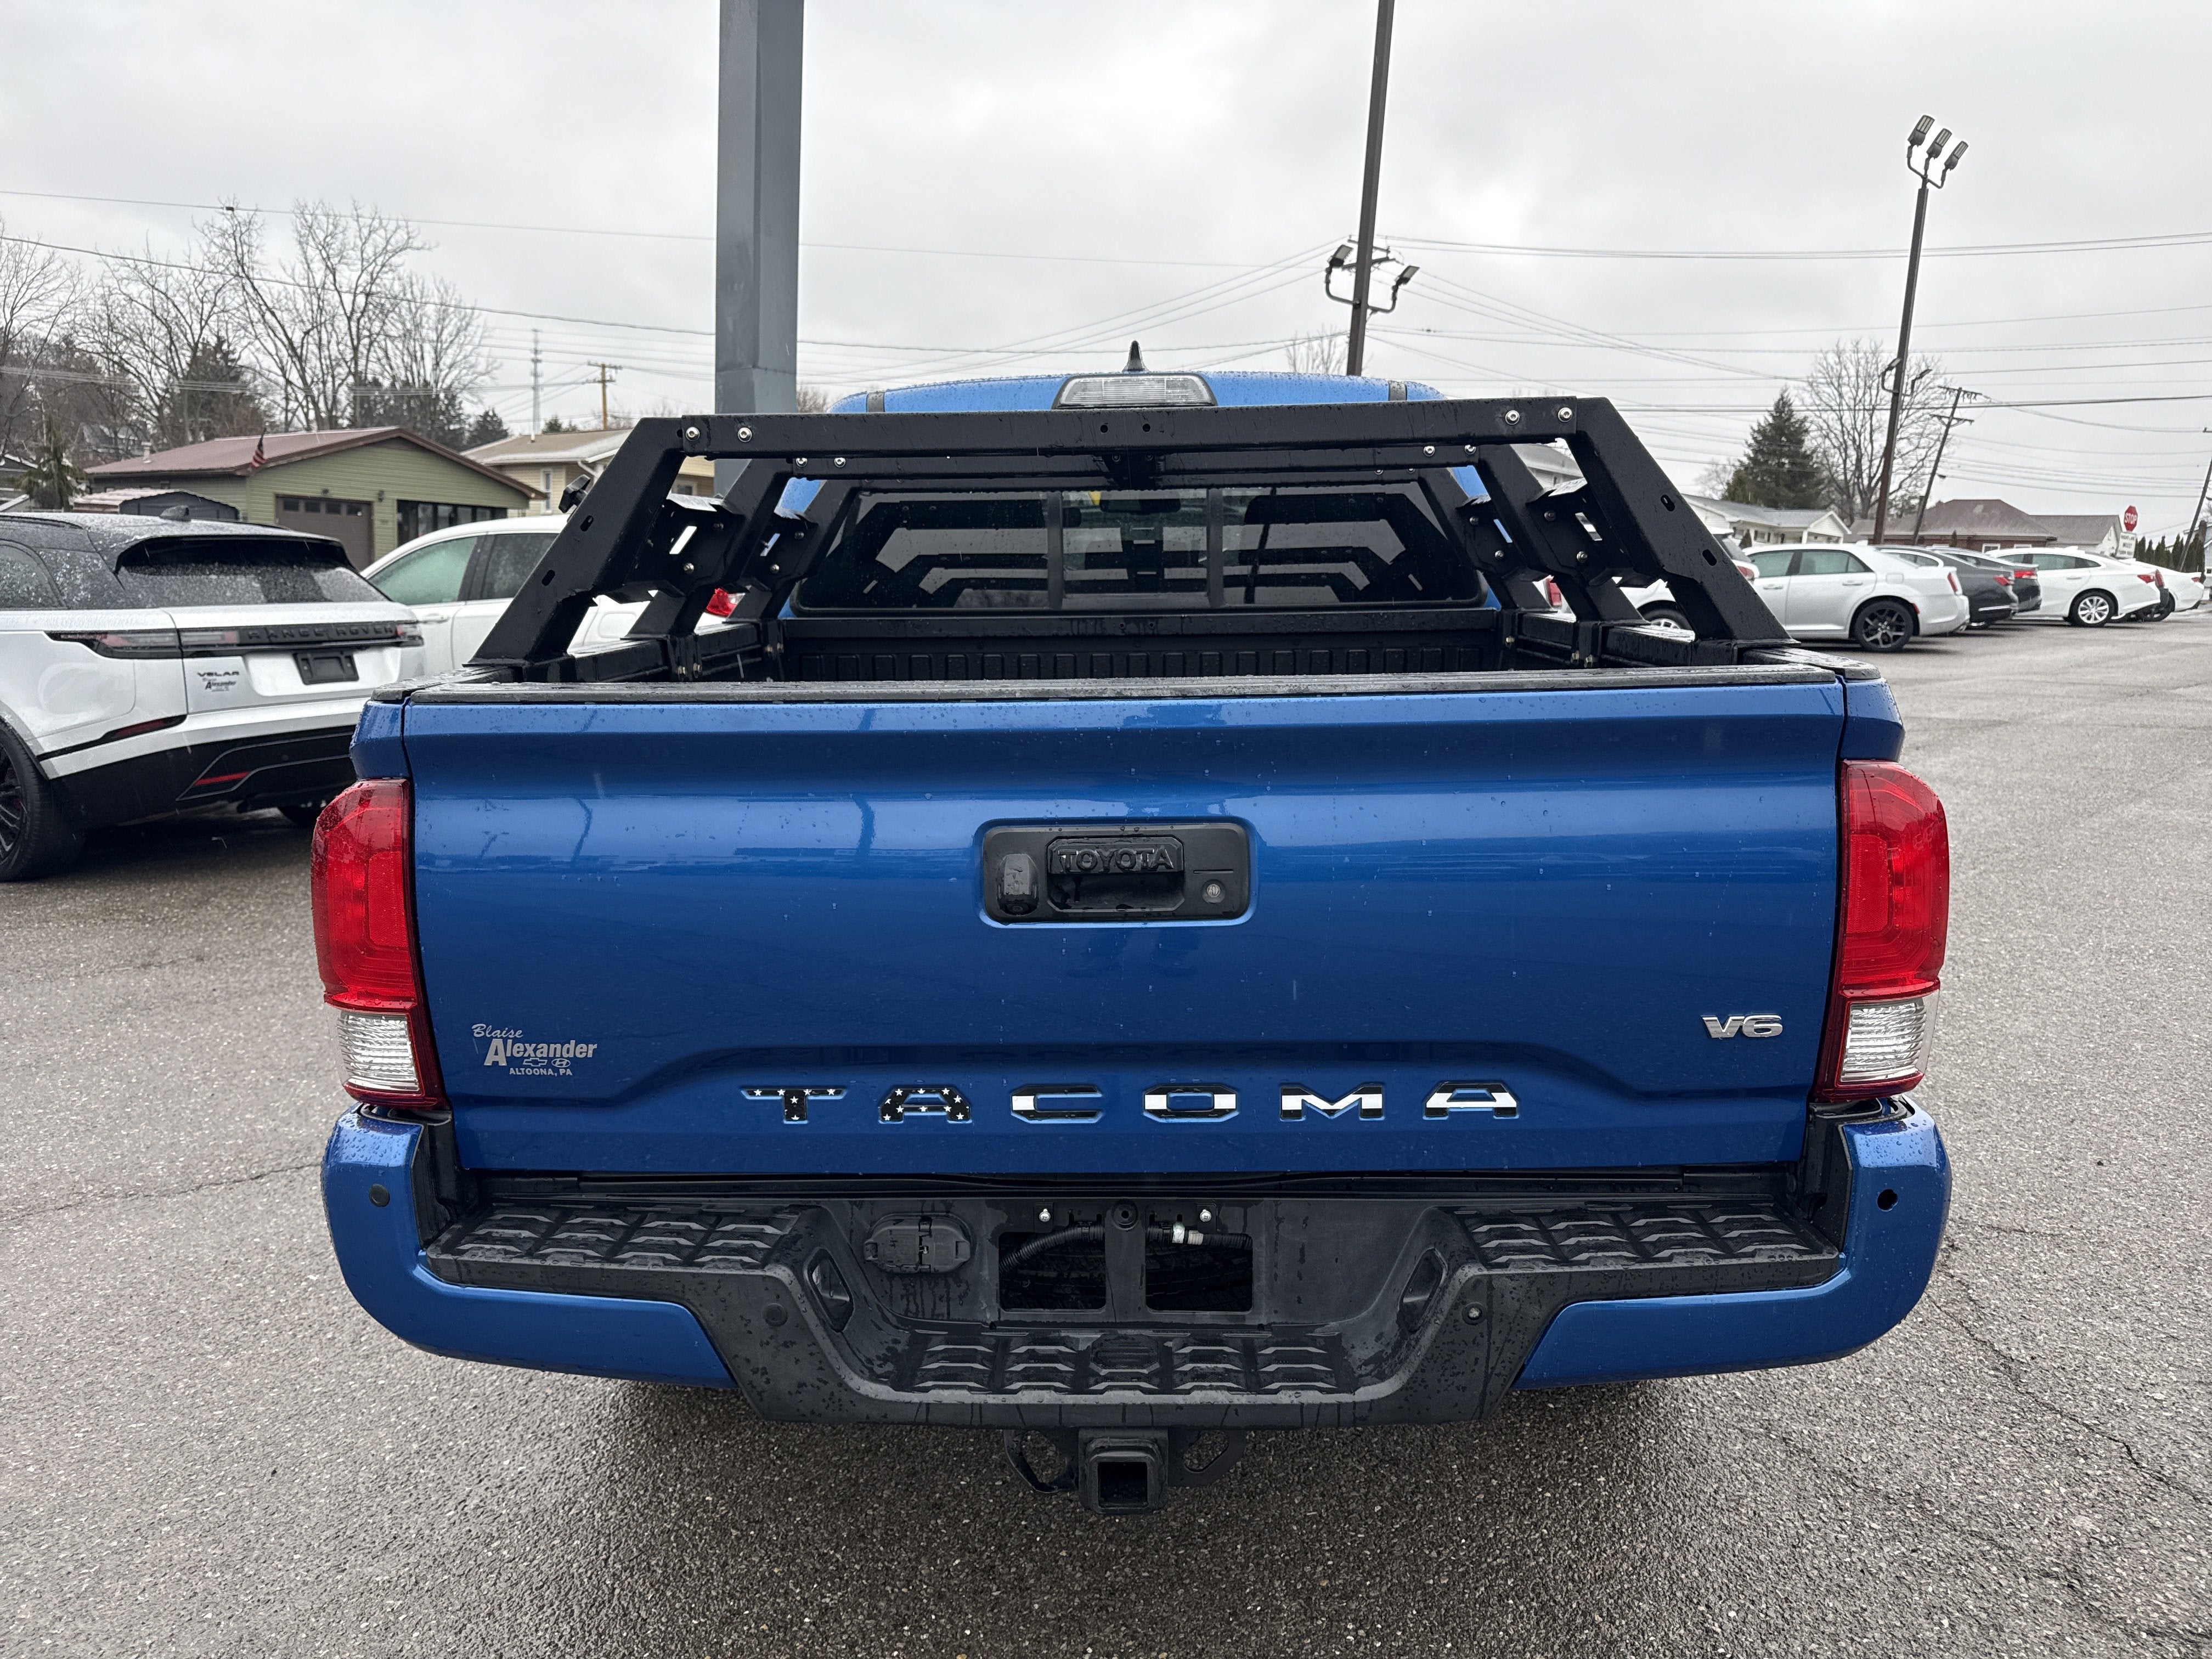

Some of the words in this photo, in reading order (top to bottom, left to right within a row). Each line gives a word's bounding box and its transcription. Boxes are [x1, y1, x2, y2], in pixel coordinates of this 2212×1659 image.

[2125, 512, 2137, 524] STOP
[247, 627, 325, 640] RANGE
[335, 624, 393, 636] ROVER
[1058, 845, 1175, 872] TOYOTA
[471, 1023, 523, 1038] Blaise
[1702, 1014, 1783, 1039] V6
[483, 1039, 597, 1066] Alexander
[509, 1068, 557, 1077] ALTOONA,
[741, 1083, 1519, 1124] TACOMA
